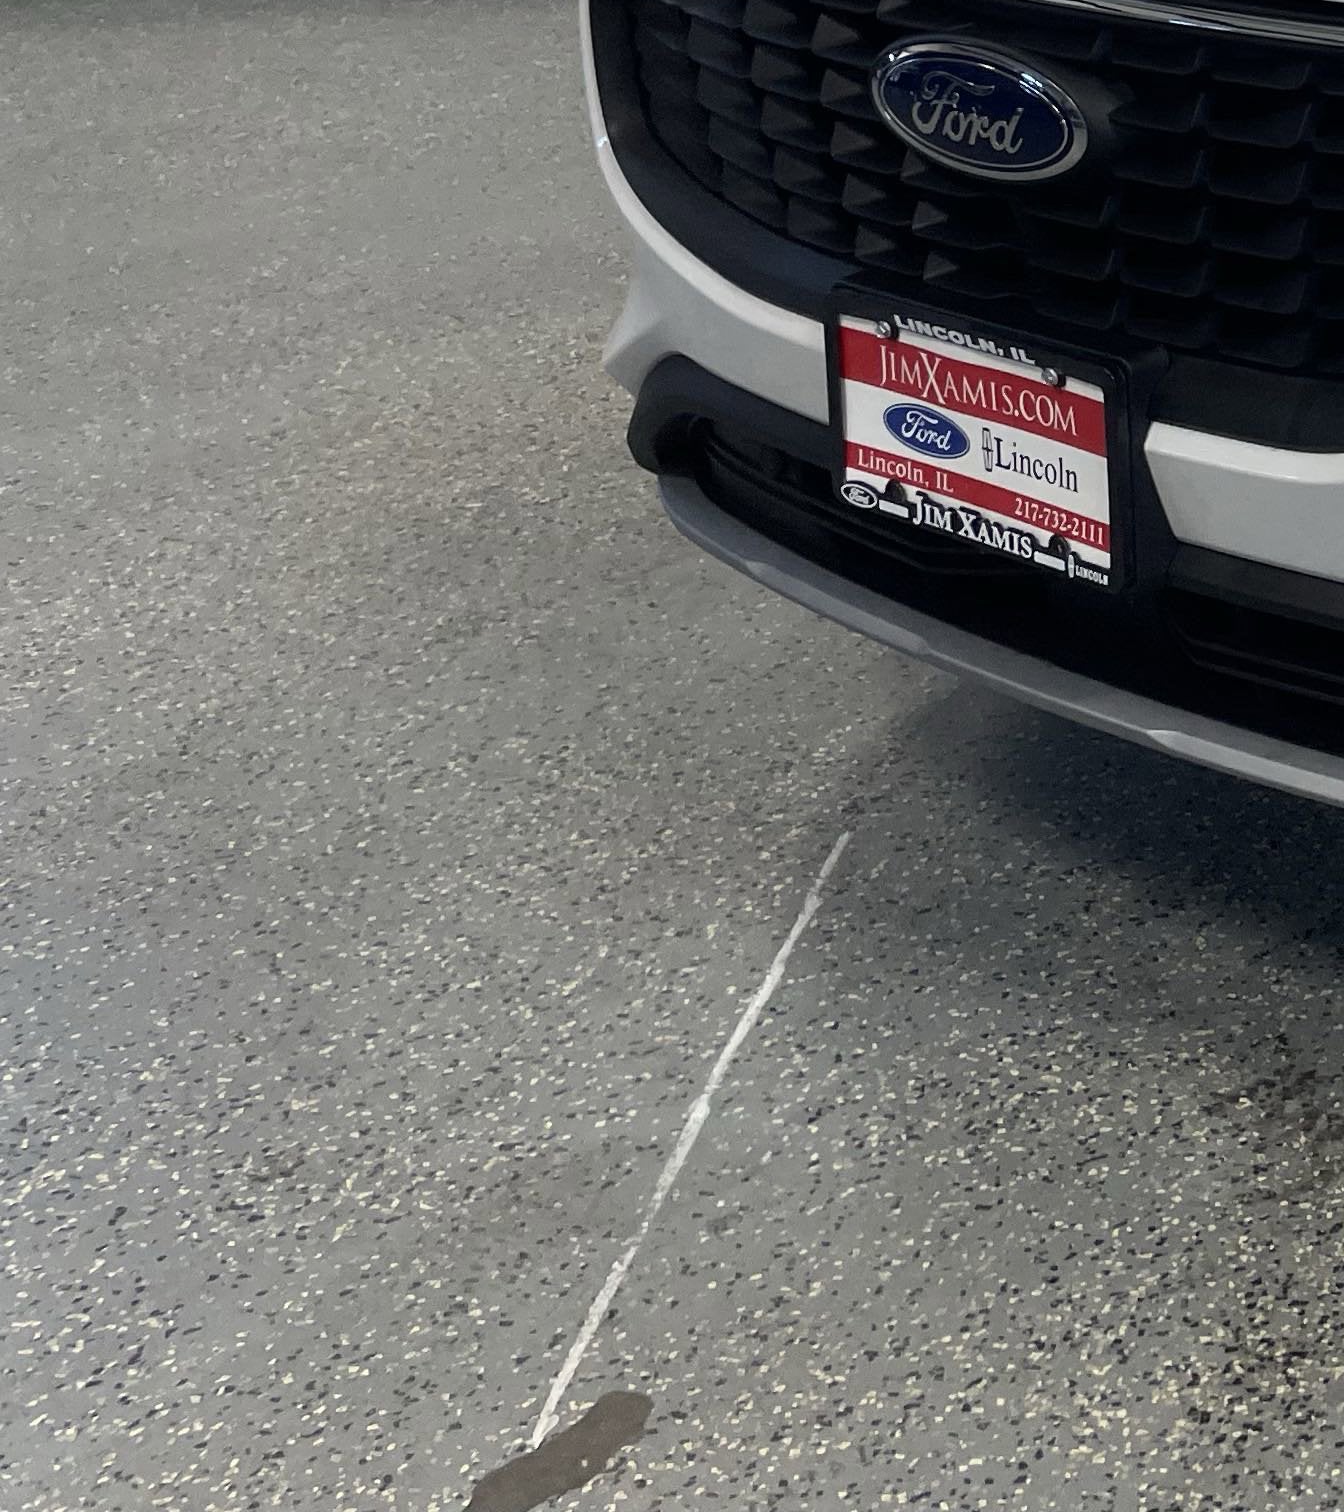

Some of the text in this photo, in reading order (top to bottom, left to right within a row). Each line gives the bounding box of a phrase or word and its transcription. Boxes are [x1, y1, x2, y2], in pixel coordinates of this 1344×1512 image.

[911, 70, 1025, 154] Ford
[893, 314, 1036, 364] LINCOLN, IL
[901, 409, 952, 452] Ford
[857, 449, 954, 492] Lincoln, IL
[993, 437, 1079, 493] Lincoln
[912, 495, 1034, 558] JIM XAMIS
[1014, 497, 1105, 546] 217-732-2111
